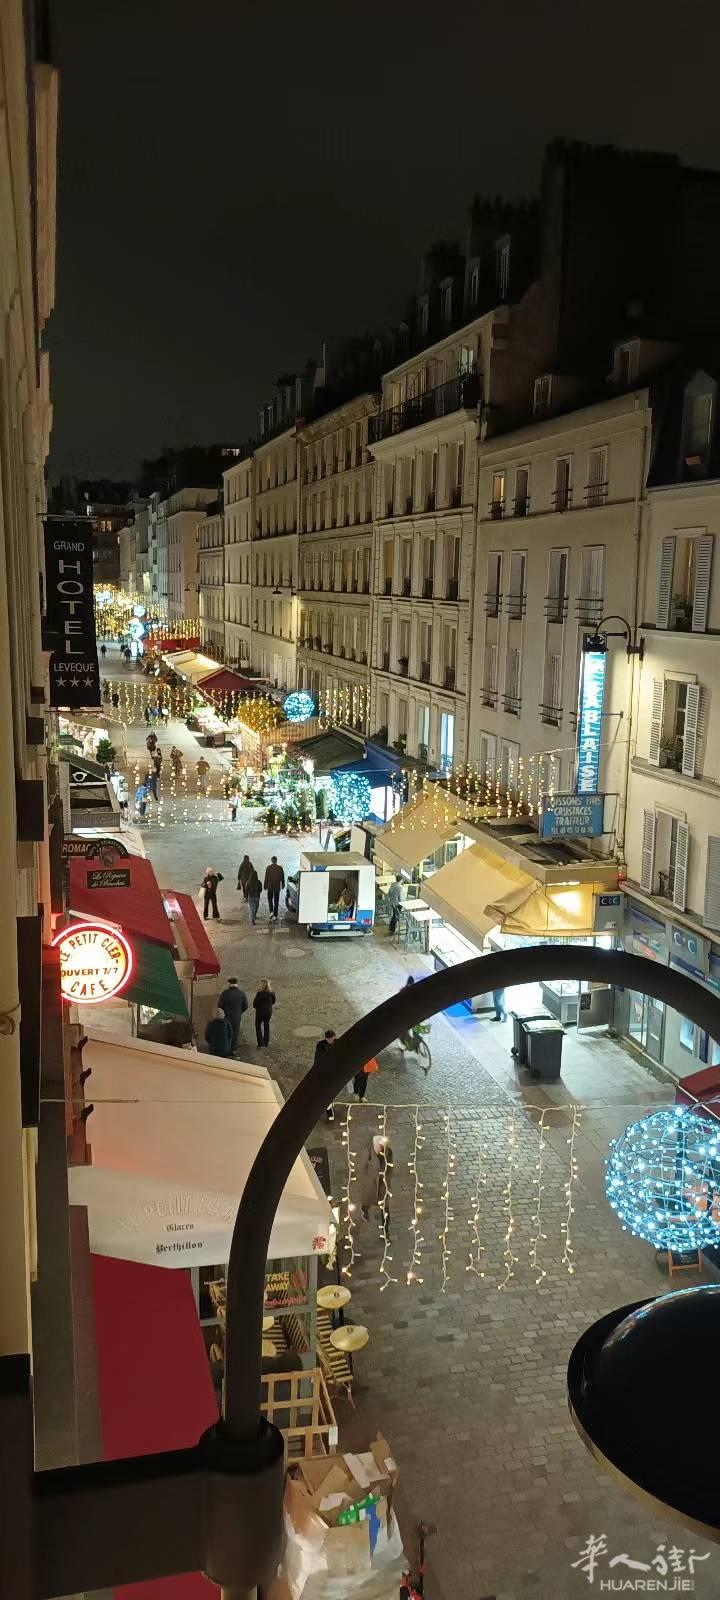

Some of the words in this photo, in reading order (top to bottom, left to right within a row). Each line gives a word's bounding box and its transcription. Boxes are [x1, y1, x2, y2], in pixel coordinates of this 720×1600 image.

[53, 541, 85, 552] GRAND
[57, 559, 85, 655] HOTEL
[54, 663, 95, 672] LEVEQUE
[555, 816, 590, 826] TRAITEUR
[69, 933, 98, 949] PETIT
[61, 968, 99, 977] OUVERT
[70, 980, 108, 995] CAFE
[166, 1223, 194, 1232] Glaces
[266, 1271, 290, 1281] TAKE
[265, 1281, 289, 1291] AWAY
